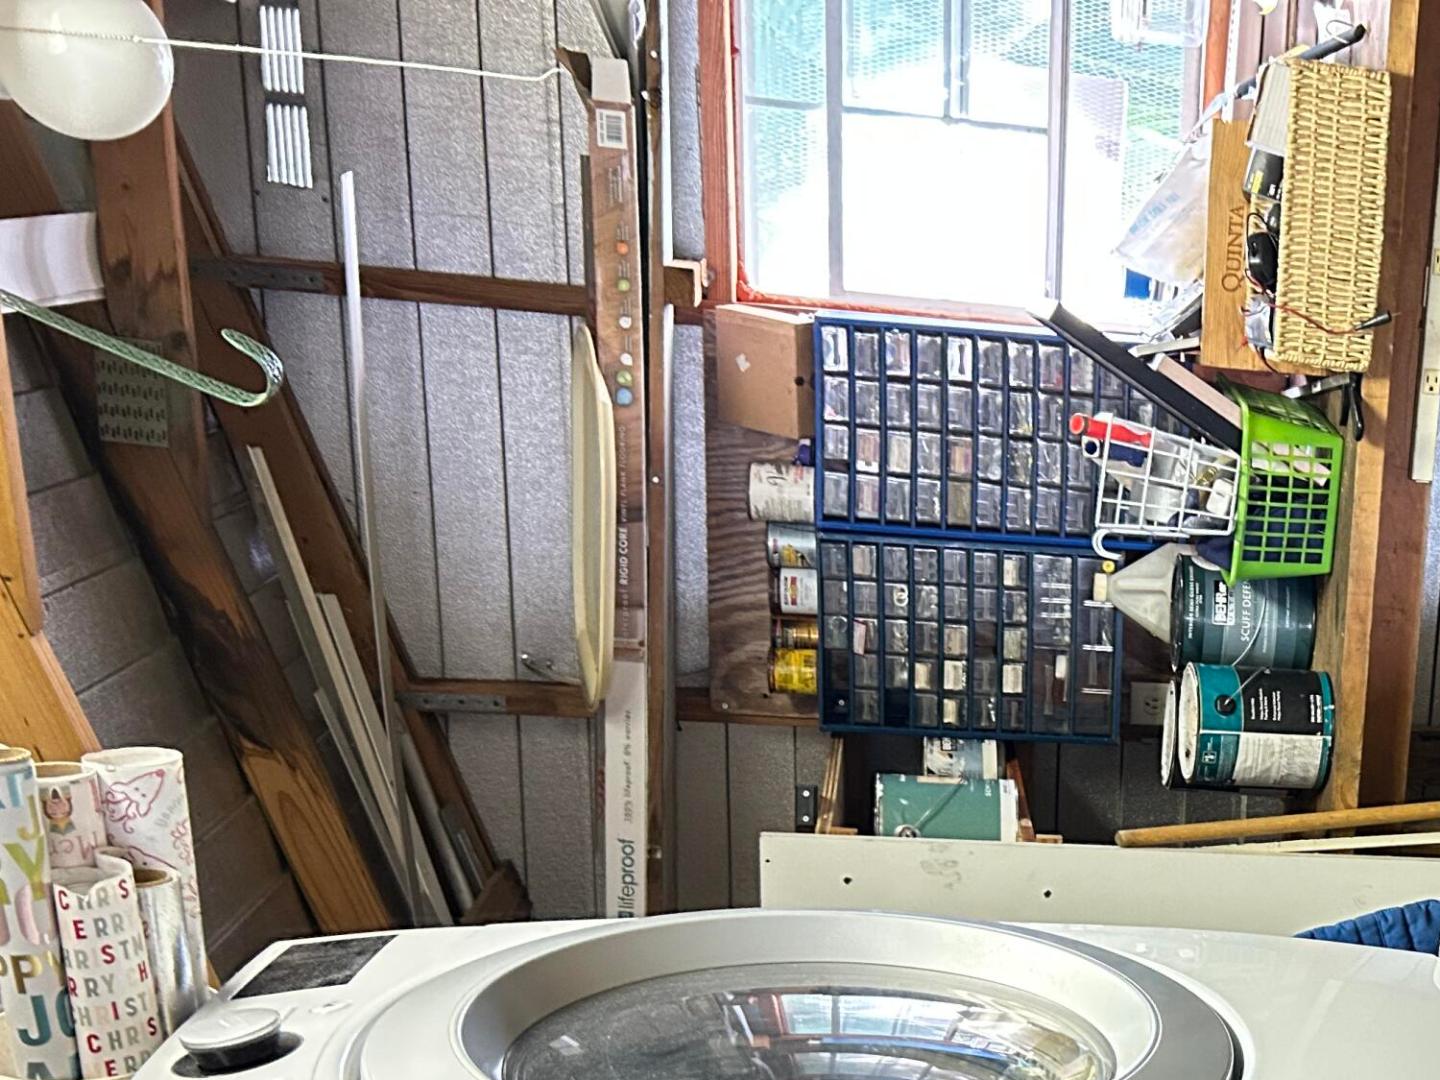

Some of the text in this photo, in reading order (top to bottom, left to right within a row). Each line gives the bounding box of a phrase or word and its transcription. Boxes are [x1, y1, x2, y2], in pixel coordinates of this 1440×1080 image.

[1221, 206, 1244, 292] QUINTA
[618, 527, 628, 554] CORE
[618, 556, 628, 585] RIGID
[1214, 592, 1226, 622] BEHR
[1240, 609, 1250, 642] SCUFF
[617, 838, 638, 909] lifeproof
